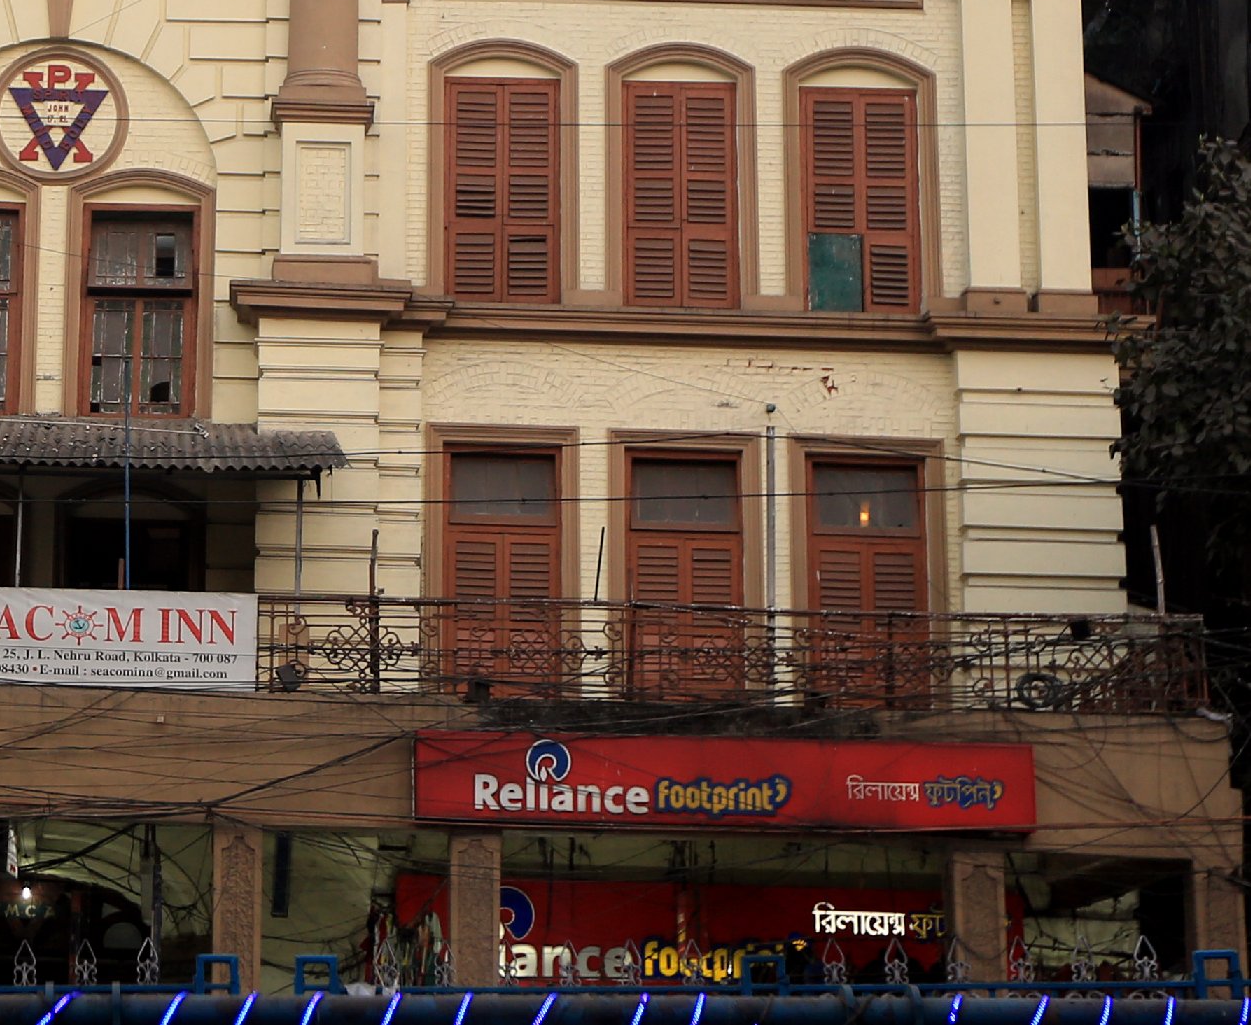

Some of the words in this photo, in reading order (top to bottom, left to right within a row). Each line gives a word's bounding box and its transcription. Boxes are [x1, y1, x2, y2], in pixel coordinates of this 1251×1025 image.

[47, 104, 70, 113] JOHN
[157, 607, 238, 646] INN
[2, 648, 21, 661] 25,
[53, 649, 91, 661] Nehru
[96, 651, 130, 664] Road,
[133, 651, 181, 664] Kolkata
[192, 653, 213, 664] 700
[216, 653, 238, 665] 087
[39, 664, 79, 676] E-mail
[90, 666, 228, 680] seacominn@gmail.com
[474, 772, 649, 814] Reliance
[658, 778, 777, 815] footprint
[811, 901, 906, 937] রিলায়েন্স
